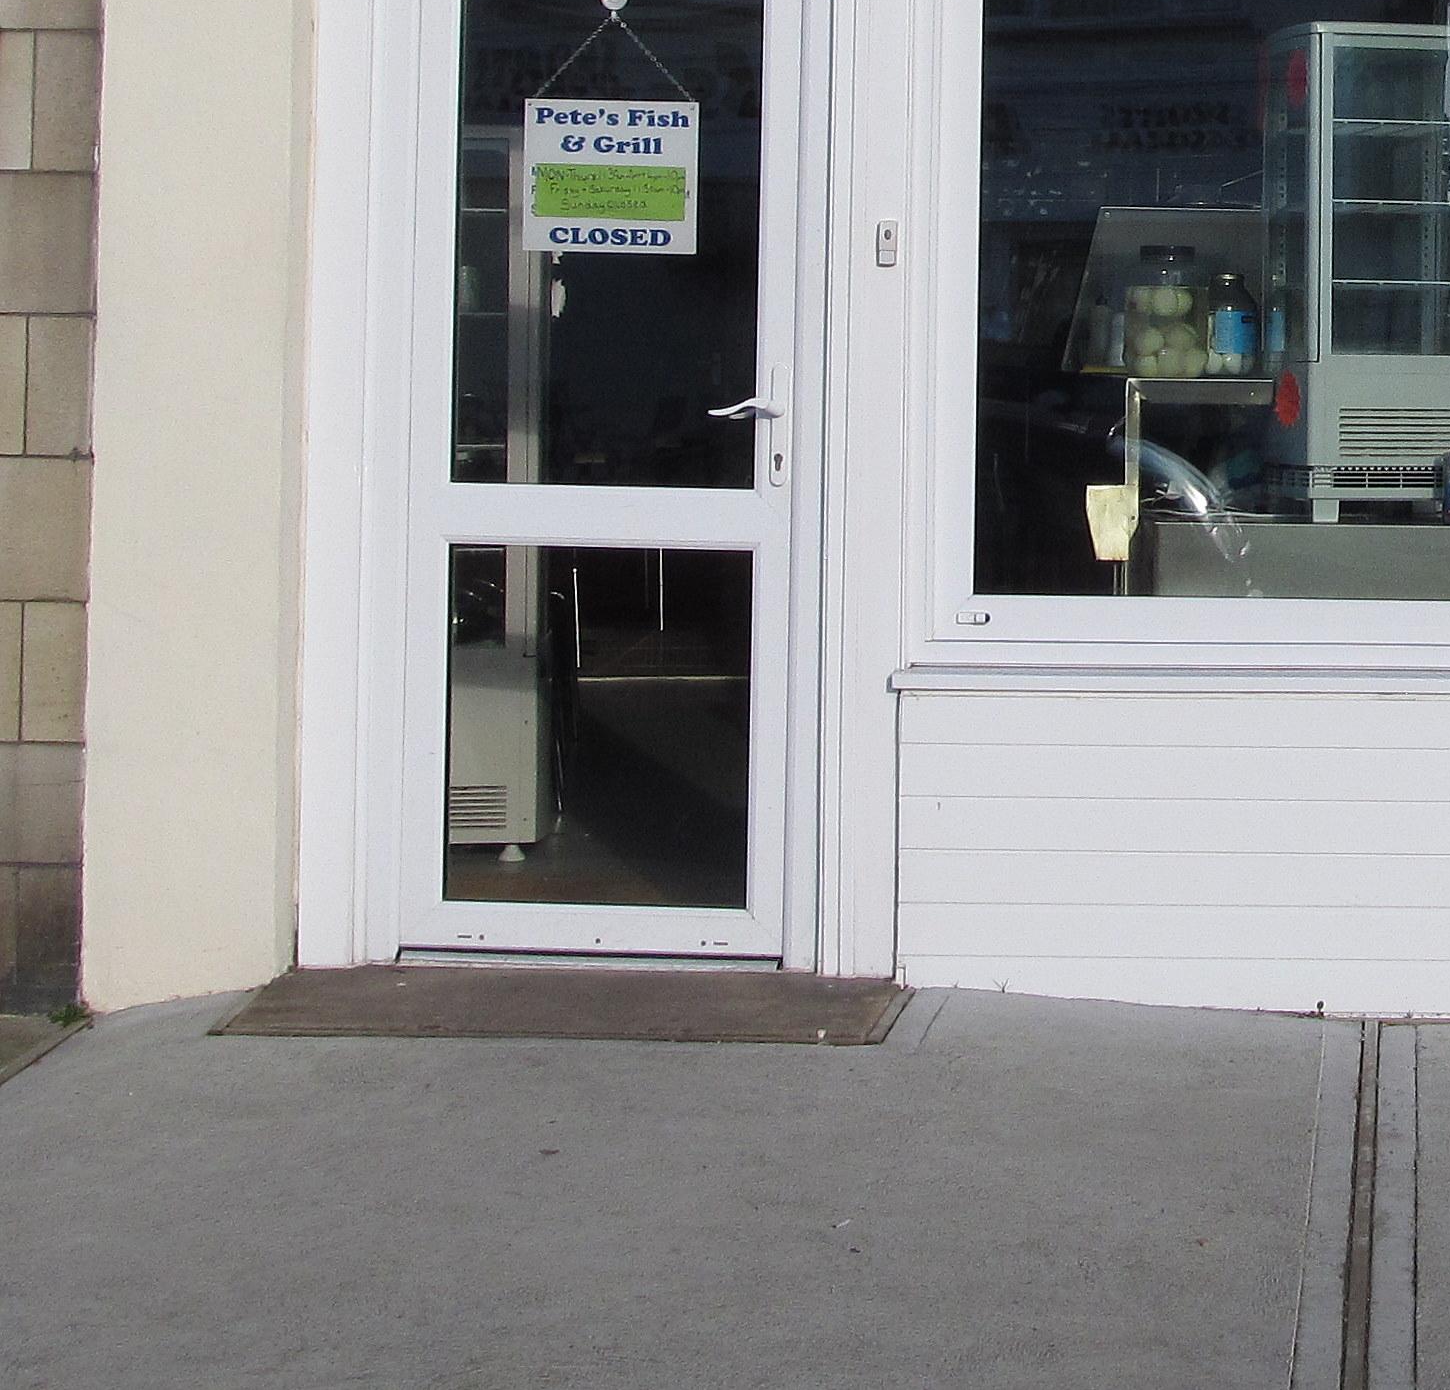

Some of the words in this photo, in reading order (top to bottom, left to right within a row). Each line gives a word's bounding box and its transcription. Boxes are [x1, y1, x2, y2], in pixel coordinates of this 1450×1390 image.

[535, 107, 619, 128] Pete's
[627, 109, 690, 128] Fish
[560, 135, 586, 153] &
[593, 136, 663, 155] Grill
[549, 226, 672, 247] CLOSED
